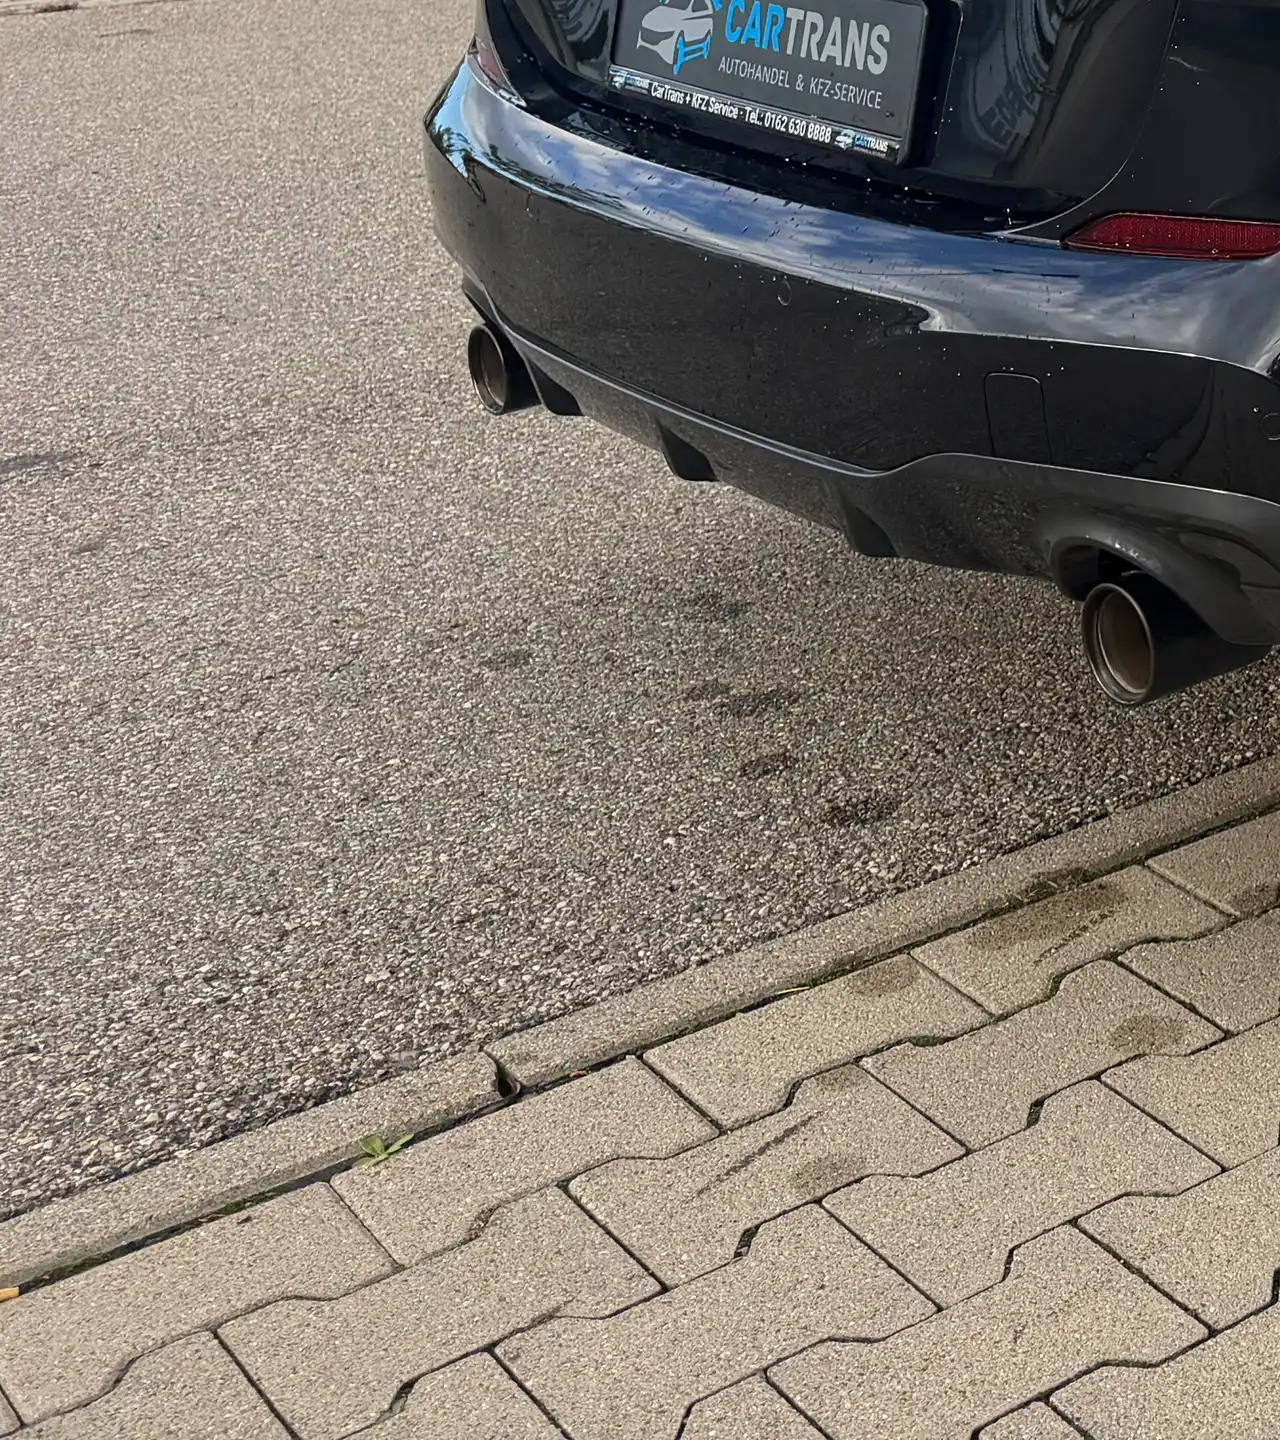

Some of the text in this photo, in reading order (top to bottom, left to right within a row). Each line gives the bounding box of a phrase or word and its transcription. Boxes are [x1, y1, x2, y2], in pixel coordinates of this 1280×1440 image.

[718, 56, 883, 109] AUTOHANDEL & KFZ-SERVICE
[651, 81, 684, 105] CarTrans
[691, 91, 709, 112] KFZ
[708, 97, 739, 119] Service
[745, 106, 764, 126] Tel.:
[764, 111, 788, 132] 0162
[788, 118, 806, 137] 630
[807, 122, 832, 143] 8888
[854, 134, 889, 152] CARTRANS
